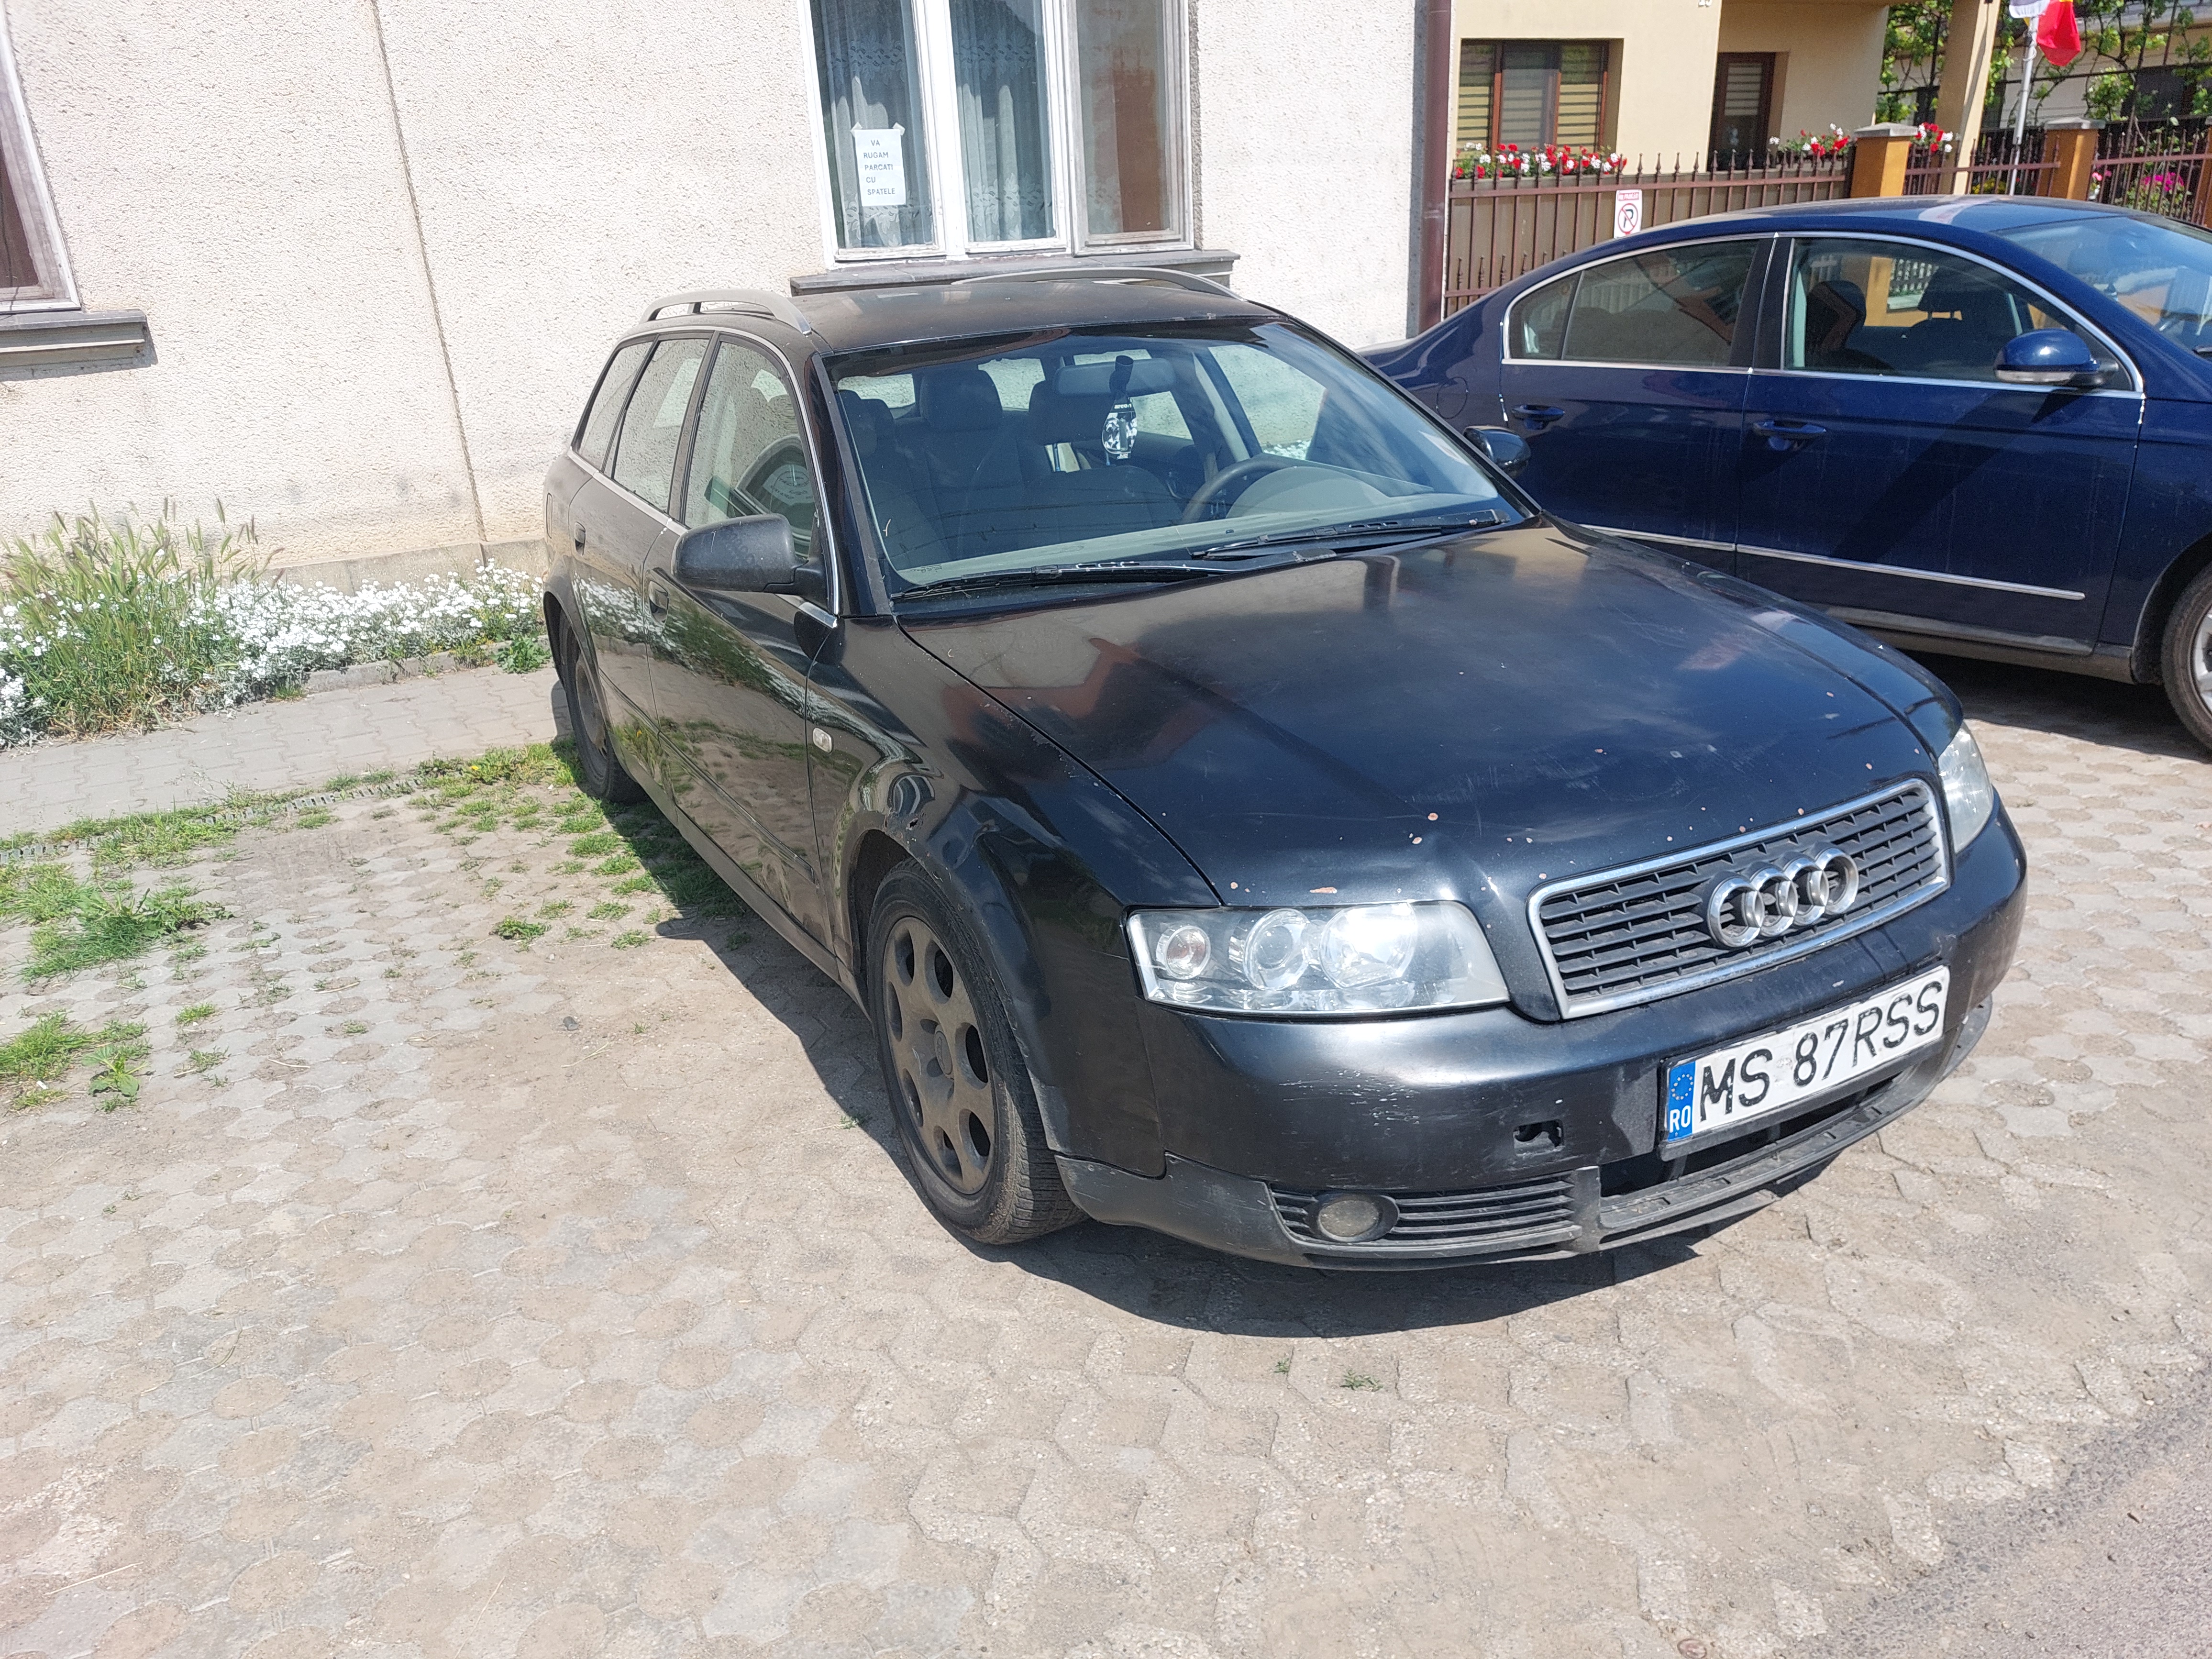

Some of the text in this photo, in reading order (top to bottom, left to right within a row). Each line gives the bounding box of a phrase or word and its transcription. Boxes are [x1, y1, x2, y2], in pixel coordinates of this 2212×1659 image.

[1700, 981, 1942, 1122] MS 87 RSS
[1670, 1105, 1691, 1133] RO
